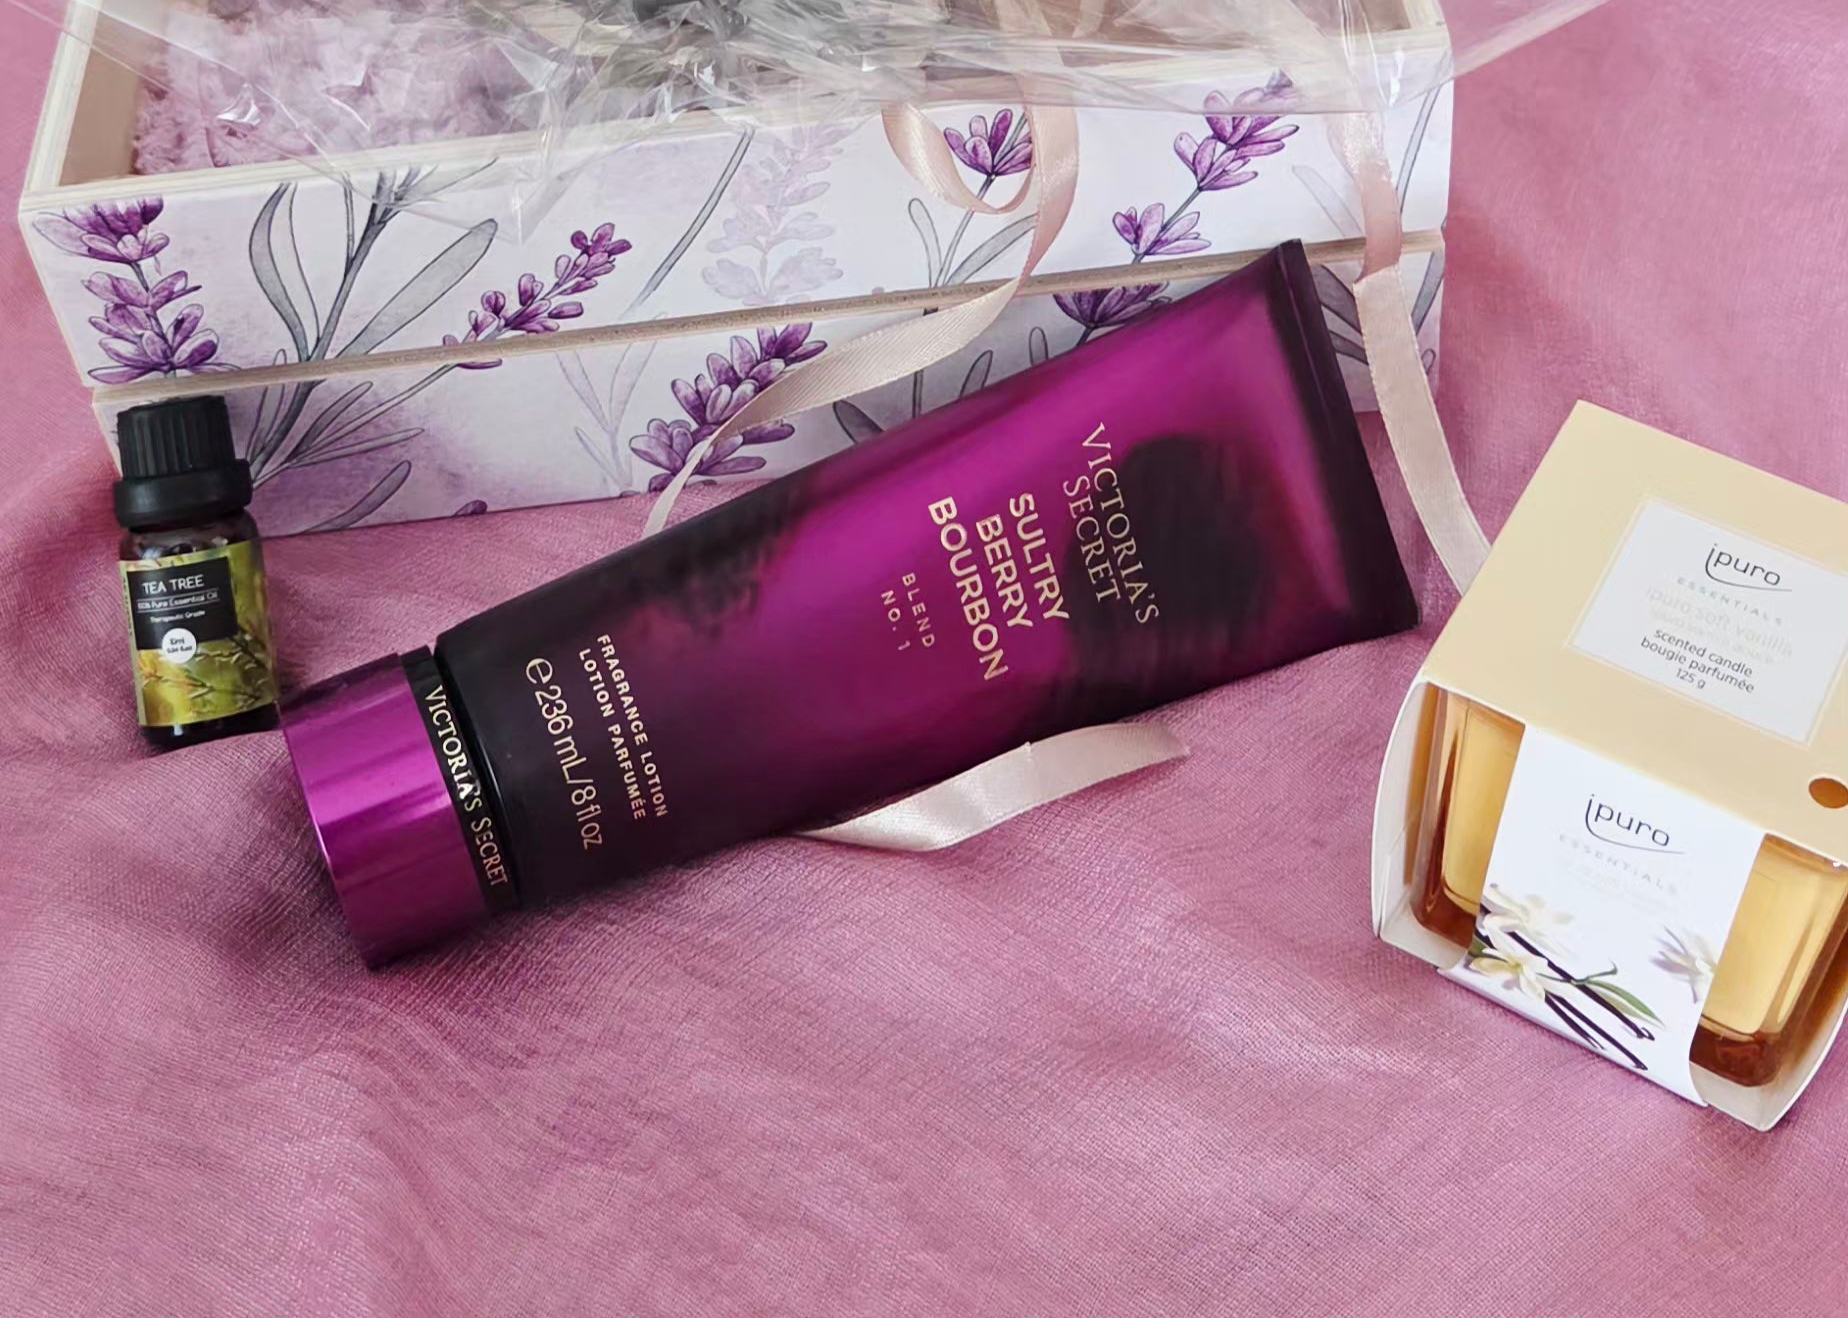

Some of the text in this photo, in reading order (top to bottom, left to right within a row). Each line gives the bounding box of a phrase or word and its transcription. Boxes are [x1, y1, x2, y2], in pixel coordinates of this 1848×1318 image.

[975, 514, 1034, 628] BERRY
[1009, 493, 1070, 620] SULTRY
[1063, 475, 1121, 603] SECRET
[1082, 422, 1160, 624] VICTORIA'S
[142, 574, 205, 595] TEA TREE
[881, 589, 911, 651] NO. 1
[902, 572, 935, 648] BLEND
[928, 496, 1009, 681] BOURBON
[1676, 576, 1783, 627] ESSENTIALS
[1640, 636, 1687, 665] bougie
[1688, 658, 1755, 694] parfumée
[1653, 628, 1708, 658] scented
[1708, 652, 1754, 678] candle
[1676, 667, 1707, 690] 125 g
[578, 648, 647, 820] LOTION PARFUMÉE
[597, 634, 668, 817] FRAGRANCE LOTION
[425, 684, 508, 886] VICTORIA'S SECRET
